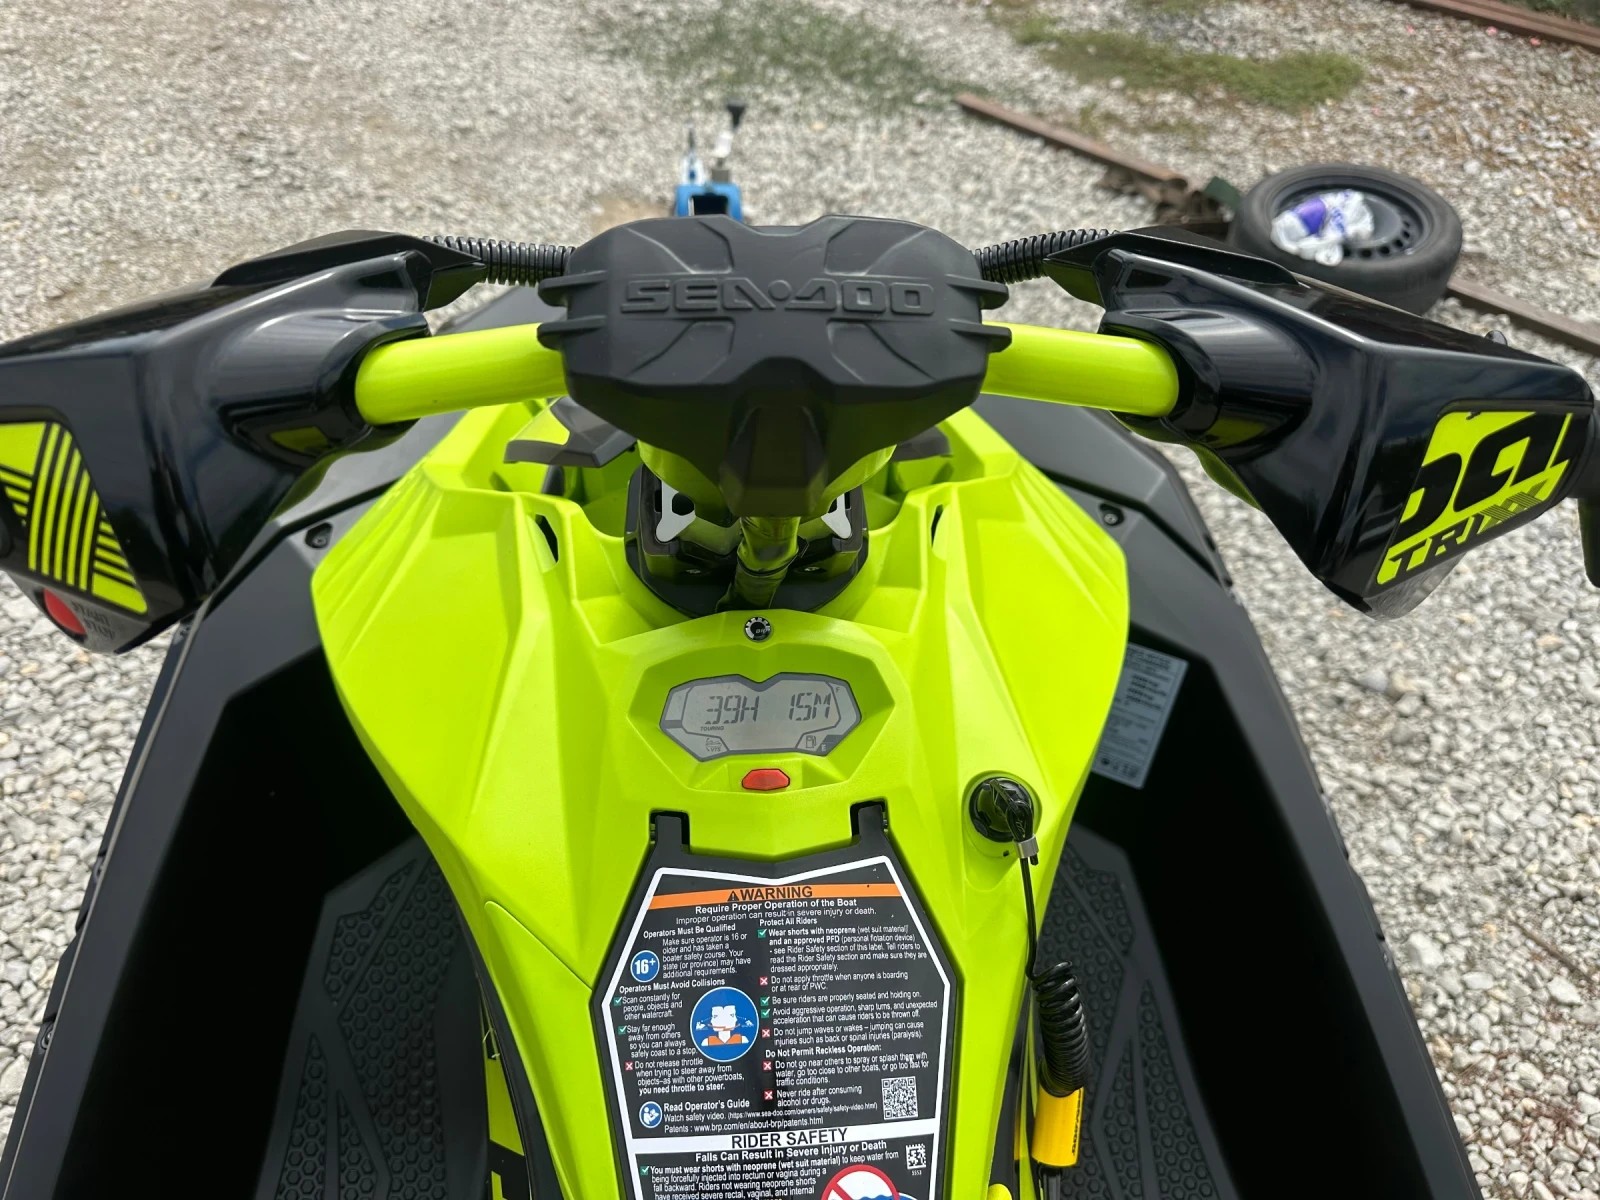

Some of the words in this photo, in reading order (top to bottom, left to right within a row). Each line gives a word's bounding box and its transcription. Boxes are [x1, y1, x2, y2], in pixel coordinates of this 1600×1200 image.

[704, 695, 760, 725] 39H
[788, 692, 832, 721] 15M
[740, 886, 814, 900] WARNING
[695, 904, 730, 916] Require
[731, 902, 762, 914] Proper
[763, 900, 808, 911] Operation
[820, 899, 835, 907] the
[836, 898, 857, 907] Boat
[676, 916, 709, 926] Improper
[711, 913, 747, 923] operation
[823, 909, 843, 917] injury
[643, 929, 676, 940] Operators
[677, 927, 693, 935] Must
[705, 924, 736, 933] Qualified
[825, 928, 856, 936] neoprene
[695, 935, 722, 945] operator
[793, 936, 824, 946] approved
[840, 935, 869, 944] (personal
[894, 934, 915, 942] device)
[663, 954, 682, 962] boater
[683, 952, 702, 962] safety
[679, 962, 688, 970] (or
[689, 960, 718, 970] province)
[620, 984, 652, 995] Operators
[652, 982, 669, 991] Must
[670, 981, 690, 989] Avoid
[691, 978, 725, 988] Collisions
[638, 994, 670, 1004] constantly
[646, 1002, 669, 1011] objects
[627, 1025, 640, 1034] Stay
[651, 1023, 675, 1033] enough
[663, 1039, 686, 1048] always
[631, 1050, 649, 1059] safely
[791, 1048, 814, 1056] Permit
[815, 1046, 845, 1055] Reckless
[846, 1044, 882, 1054] Operation:
[656, 1059, 680, 1067] release
[681, 1057, 703, 1065] throttle
[670, 1084, 695, 1092] throttle
[827, 1086, 862, 1096] consuming
[664, 1103, 683, 1112] Read
[684, 1100, 725, 1112] Operator's
[726, 1099, 750, 1108] Guide
[777, 1098, 801, 1106] alcohol
[810, 1096, 830, 1106] drugs.
[664, 1114, 684, 1122] Watch
[685, 1113, 705, 1123] safety
[706, 1112, 726, 1120] video.
[664, 1124, 689, 1133] Patents
[694, 1116, 823, 1133] www.brp.com/en/about-brp/patents.html
[731, 1134, 781, 1149] RIDER
[786, 1128, 848, 1146] SAFETY
[696, 1152, 718, 1162] Falls
[720, 1151, 740, 1161] Can
[741, 1149, 772, 1160] Result
[785, 1146, 819, 1157] Severe
[821, 1143, 847, 1156] Injury
[861, 1140, 887, 1151] Death
[664, 1166, 682, 1174] must
[701, 1164, 724, 1172] shorts
[742, 1163, 776, 1172] neoprene
[795, 1159, 809, 1167] suit
[841, 1156, 848, 1164] to
[849, 1154, 865, 1164] keep
[866, 1152, 883, 1161] water
[884, 1150, 899, 1159] from
